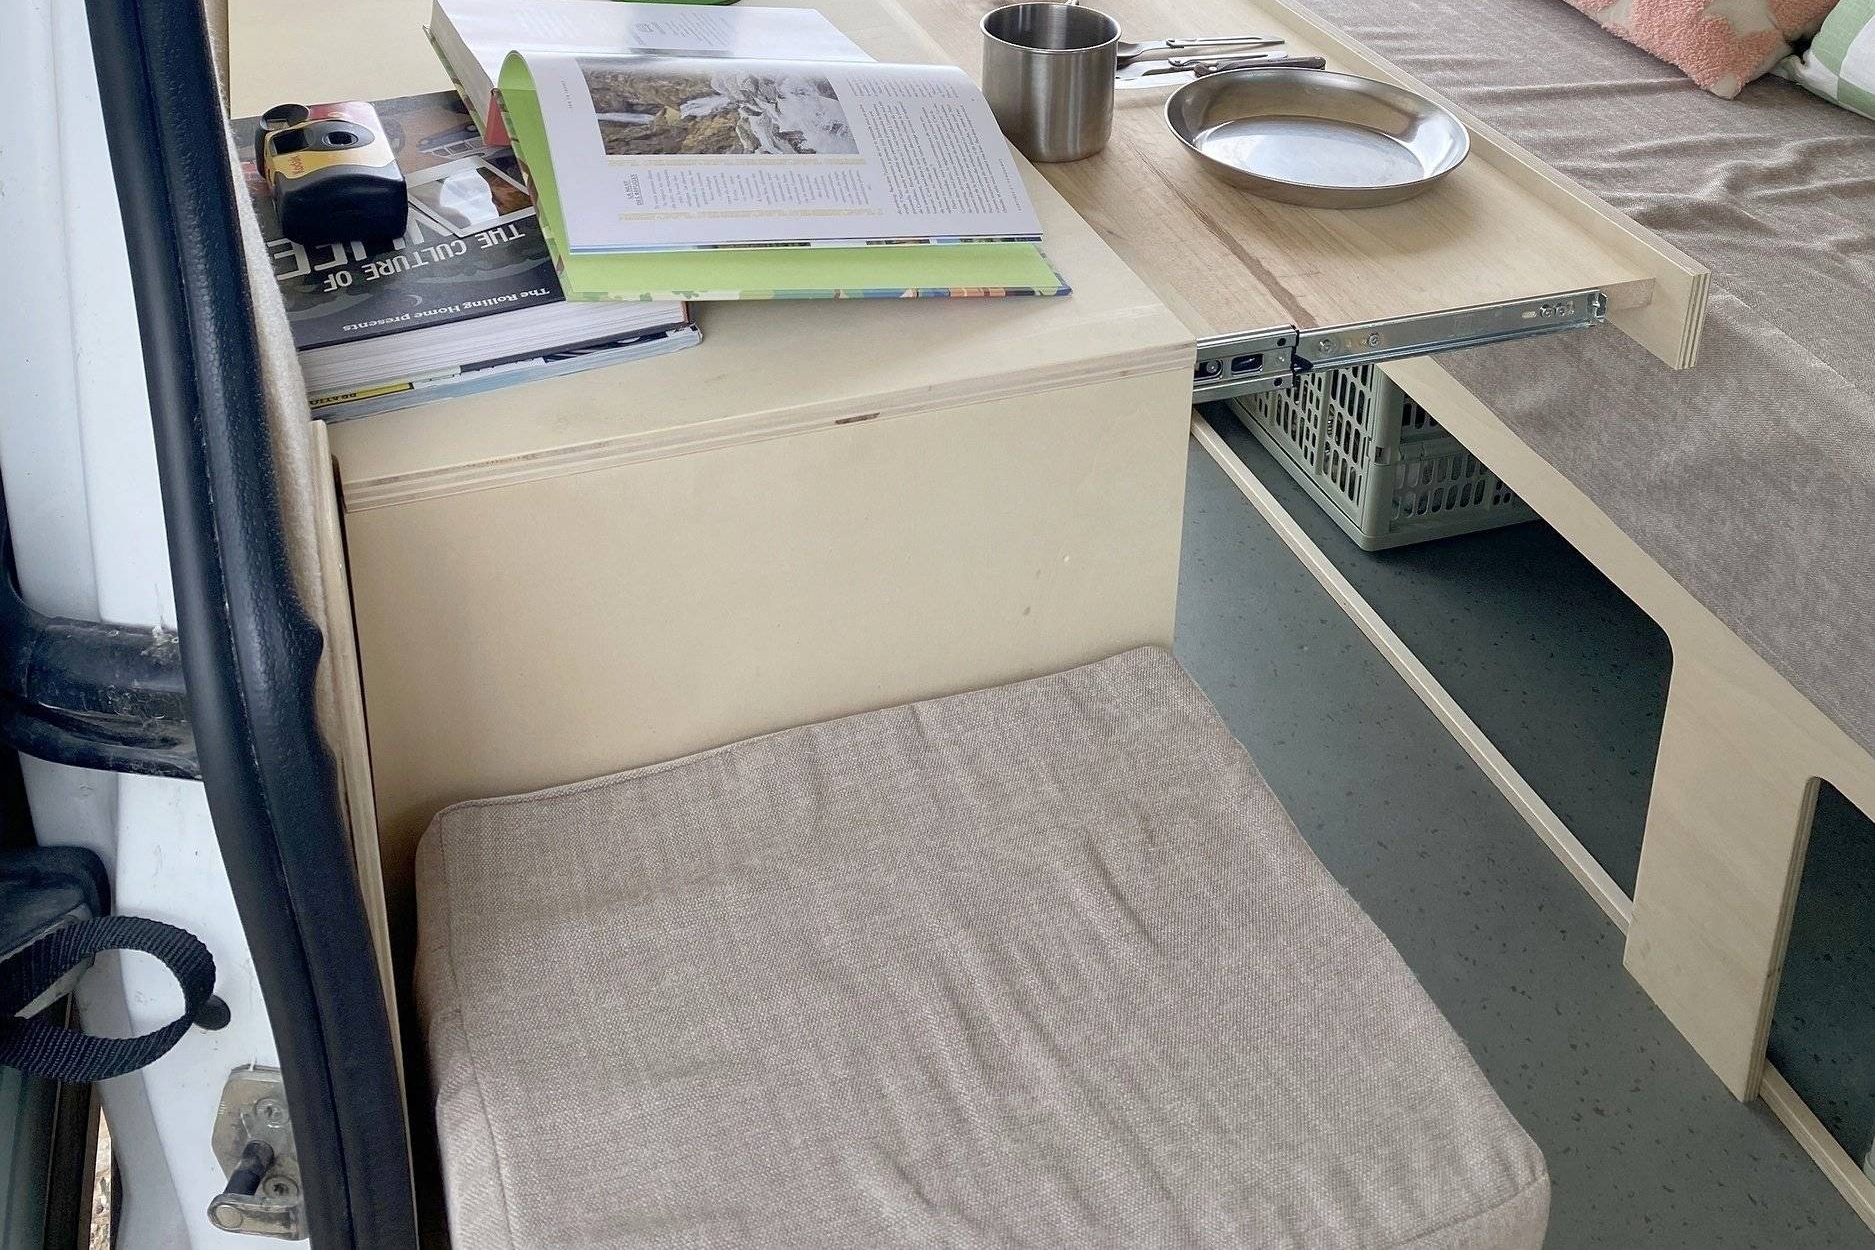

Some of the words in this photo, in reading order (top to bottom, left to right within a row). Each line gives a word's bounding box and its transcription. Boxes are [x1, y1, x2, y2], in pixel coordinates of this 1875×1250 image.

[477, 223, 525, 249] THE
[365, 240, 468, 281] CULTURE
[323, 266, 354, 293] OF
[463, 293, 518, 310] Rolling
[520, 287, 550, 299] The
[414, 304, 460, 318] Home
[342, 312, 411, 332] presents
